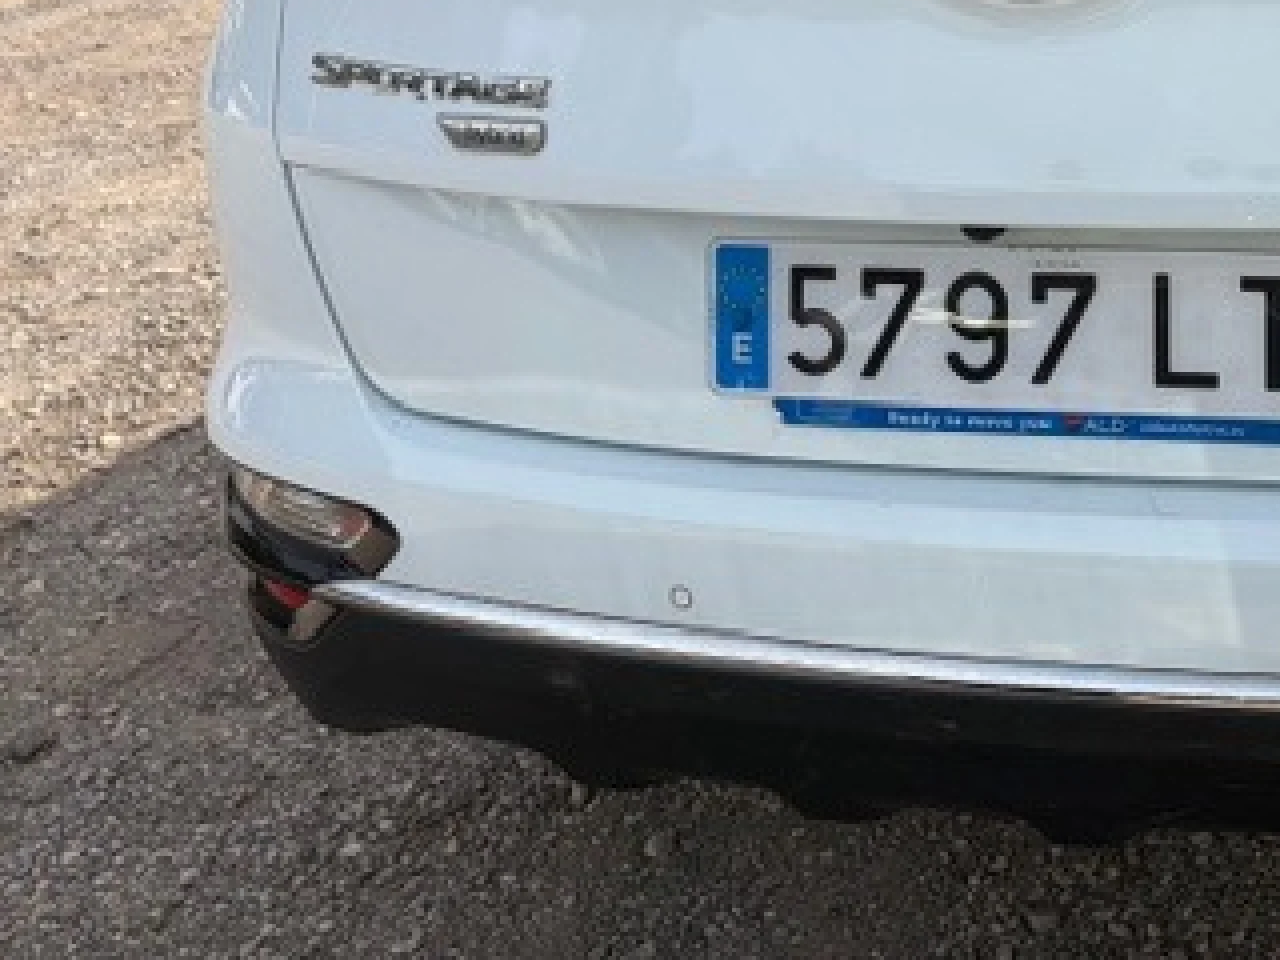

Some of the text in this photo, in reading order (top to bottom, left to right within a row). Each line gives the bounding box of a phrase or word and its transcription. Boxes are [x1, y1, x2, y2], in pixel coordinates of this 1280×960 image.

[310, 52, 552, 109] SPORTAGE
[730, 332, 752, 365] E
[786, 263, 1097, 385] 5797
